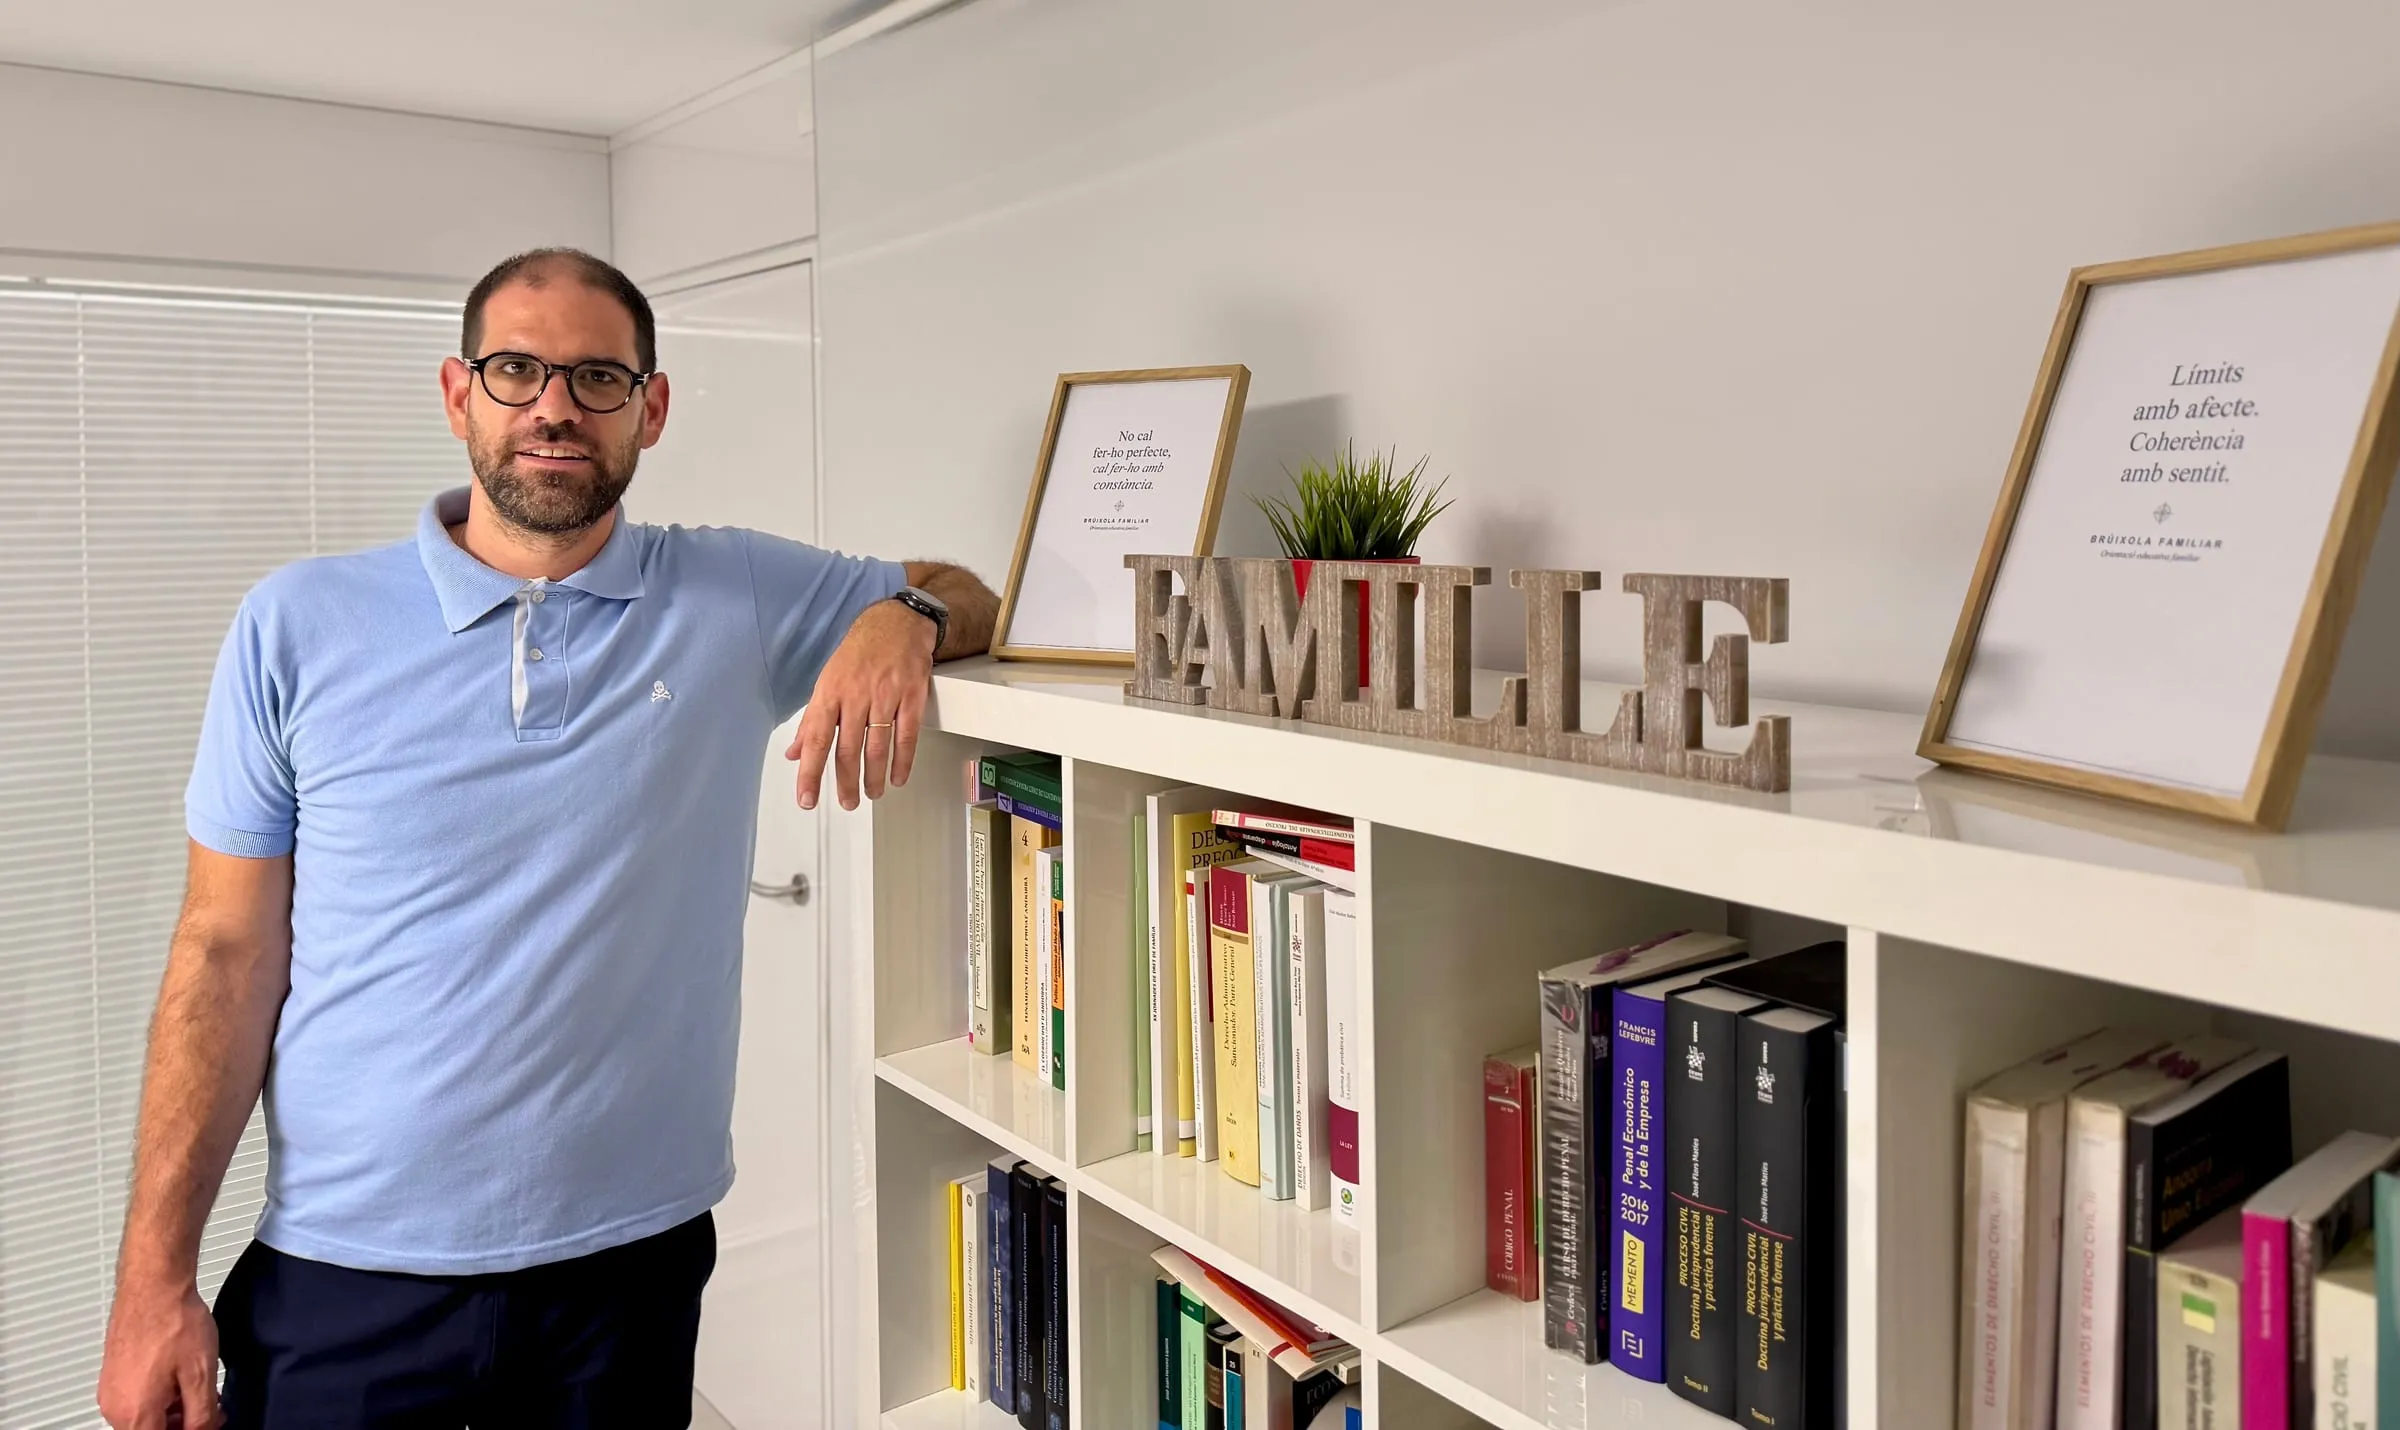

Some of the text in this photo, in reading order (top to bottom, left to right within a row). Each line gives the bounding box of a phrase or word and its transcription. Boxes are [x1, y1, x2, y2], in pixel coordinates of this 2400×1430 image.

[2170, 361, 2245, 386] Límits
[2132, 396, 2260, 421] amb afecte.
[1118, 429, 1153, 442] No cal
[2129, 428, 2245, 452] Coherència
[1092, 446, 1171, 461] fer-ho perfecte,
[1092, 462, 1165, 476] cal fer-ho amb
[2120, 461, 2230, 483] amb sentit.
[1093, 478, 1154, 490] constància.
[2090, 533, 2223, 549] BRÚIXOLA FAMILIAR
[1123, 554, 1791, 793] FAMILLE
[1021, 830, 1029, 847] 4
[1228, 945, 1236, 982] General
[1618, 1019, 1657, 1038] FRANCIS
[1618, 1028, 1657, 1047] LEFEBVRE
[1622, 1067, 1635, 1186] Penal Económico
[1636, 1079, 1653, 1192] y de la Empresa
[1691, 1163, 1700, 1181] Flors
[1691, 1181, 1700, 1198] José
[1760, 1187, 1769, 1207] Flors
[1503, 1188, 1513, 1225] PENAL
[1560, 1137, 1571, 1278] CURSO DE DERECHO PENAL
[1620, 1192, 1650, 1212] 2016
[1620, 1207, 1650, 1227] 2017
[1760, 1206, 1769, 1224] José
[1679, 1206, 1689, 1287] PROCESO CIVIL
[1626, 1239, 1639, 1308] MEMENTO
[1702, 1214, 1717, 1311] y práctica forense
[1746, 1232, 1757, 1315] PROCESO CIVIL
[1689, 1210, 1703, 1340] Doctrina jurisprudencial
[1986, 1248, 2000, 1310] DERECHO
[2080, 1248, 2095, 1310] DERECHO
[1770, 1241, 1786, 1341] y práctica forense
[1757, 1236, 1771, 1371] Doctrina jurisprudencial
[1985, 1313, 1998, 1330] DE
[2079, 1311, 2093, 1331] DE
[1683, 1375, 1703, 1391] Tomo
[1983, 1334, 1998, 1408] ELEMENTOS
[2077, 1335, 2092, 1408] ELEMENTOS
[1751, 1407, 1771, 1425] Tomo
